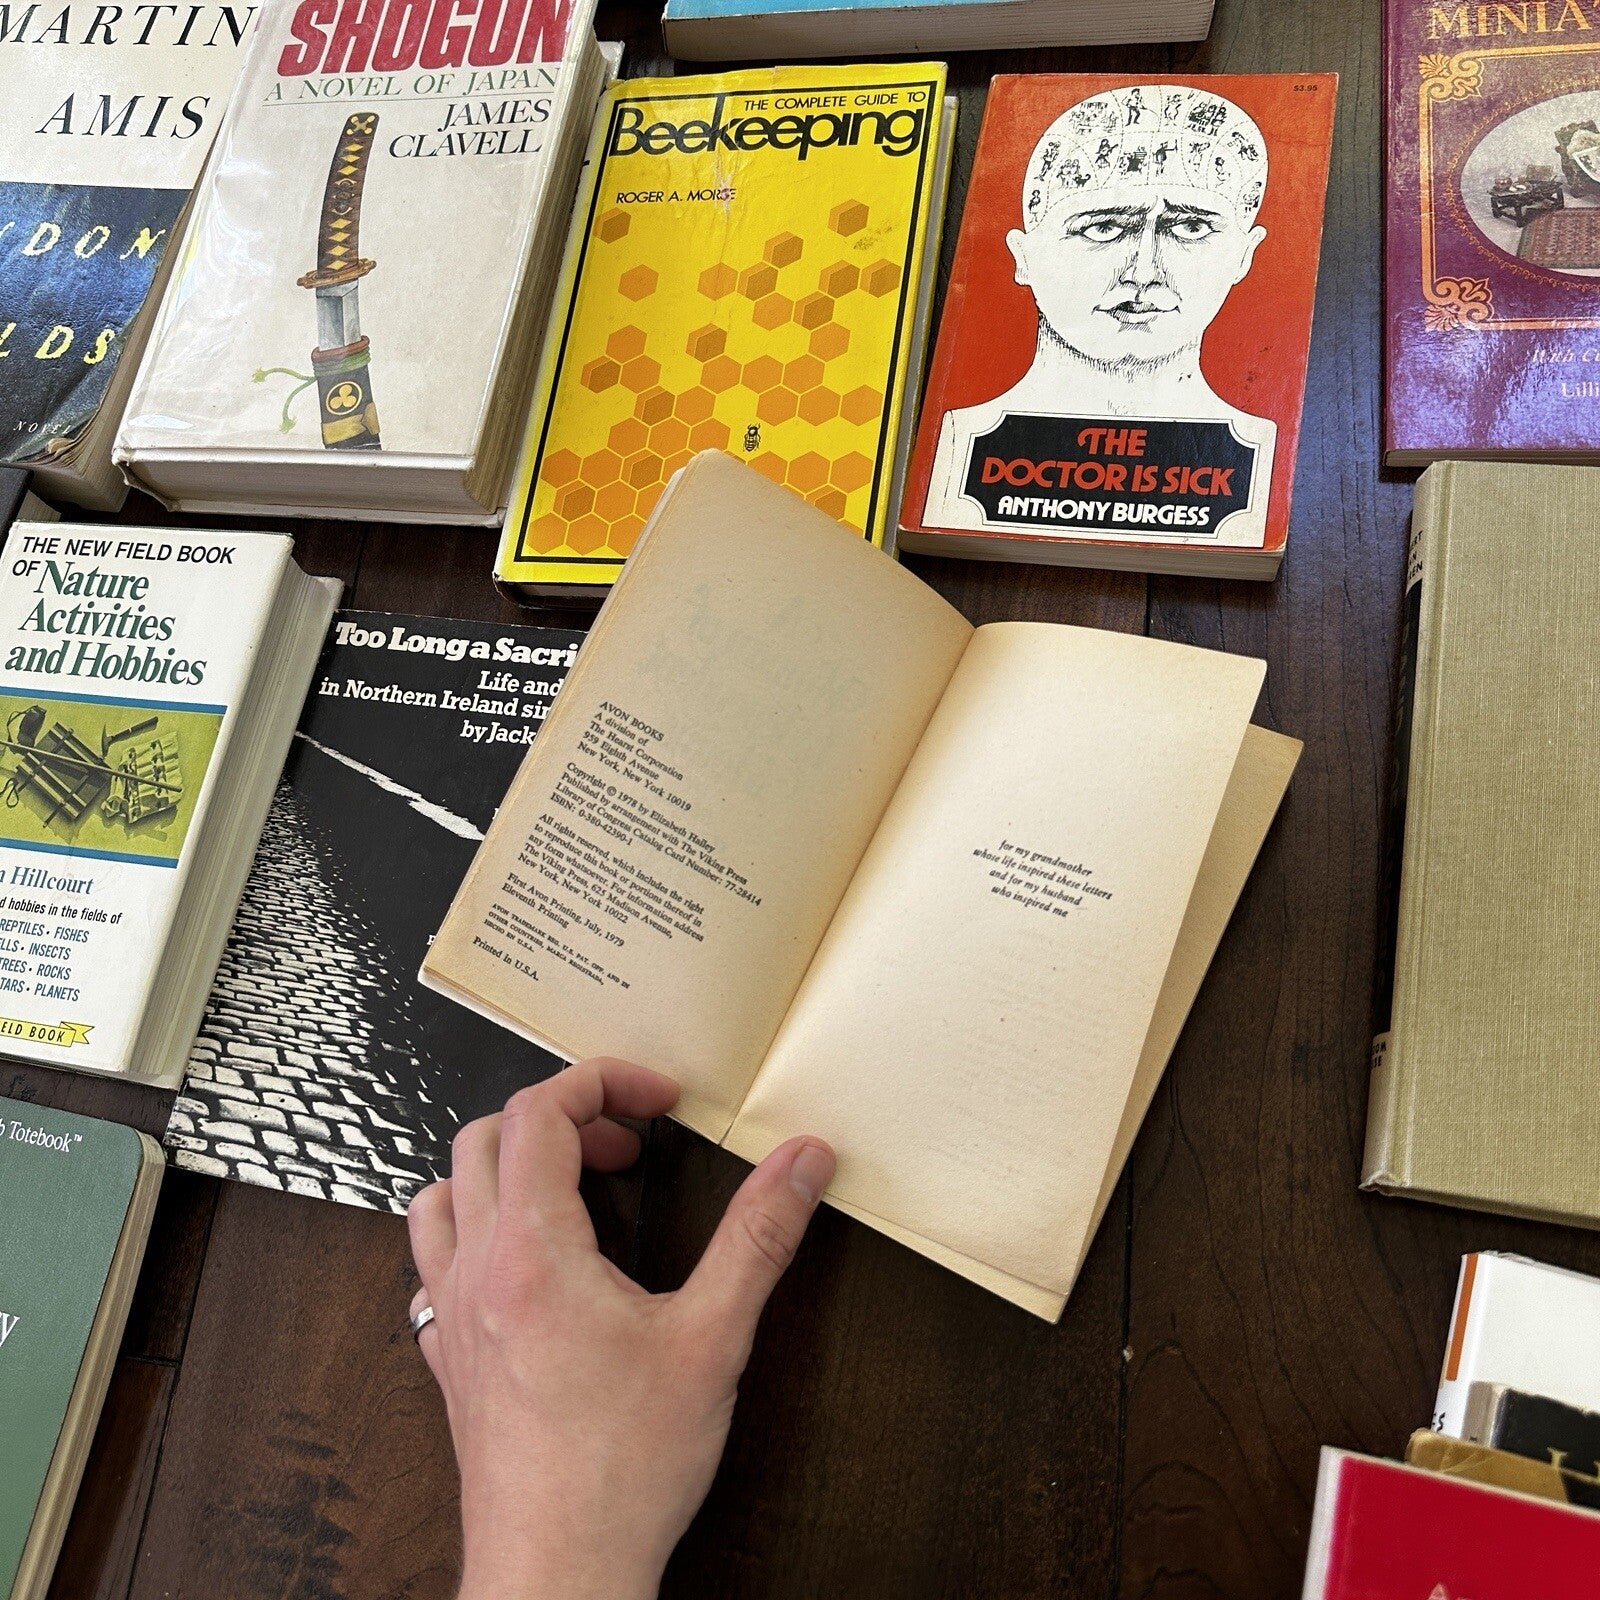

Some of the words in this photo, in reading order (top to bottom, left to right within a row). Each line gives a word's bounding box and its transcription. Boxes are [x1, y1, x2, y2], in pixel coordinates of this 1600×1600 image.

[0, 4, 258, 47] MARTIN
[277, 0, 572, 76] SHOGUN
[1427, 0, 1600, 40] MINIA
[265, 82, 282, 101] A
[298, 77, 403, 99] NOVEL
[413, 73, 455, 95] OF
[463, 68, 561, 96] JAPAN
[745, 100, 768, 111] THE
[775, 96, 847, 109] COMPLETE
[855, 93, 898, 105] GUIDE
[907, 91, 927, 103] TO
[1293, 84, 1319, 92] $3.95
[35, 92, 210, 139] AMIS
[438, 99, 552, 132] JAMES
[608, 93, 924, 161] Beekeeping
[389, 129, 545, 158] CLAVELL
[616, 191, 664, 204] ROGER
[668, 190, 683, 202] A.
[1077, 427, 1147, 456] THE
[981, 456, 1128, 492] DOCTOR
[1131, 465, 1158, 493] IS
[1161, 466, 1236, 496] SICK
[997, 495, 1112, 522] ANTHONY
[1112, 503, 1210, 526] BURGESS
[23, 536, 61, 554] THE
[68, 539, 113, 557] NEW
[115, 541, 172, 561] FIELD
[176, 545, 236, 565] BOOK
[12, 560, 41, 577] OF
[33, 560, 149, 600] Nature
[18, 598, 176, 641] Activities
[336, 622, 387, 648] Too
[388, 627, 471, 661] Long
[469, 643, 491, 659] a
[5, 640, 69, 674] and
[67, 641, 207, 686] Hobbies
[477, 670, 520, 693] Life
[319, 677, 340, 696] in
[343, 679, 437, 708] Northern
[439, 690, 518, 717] Ireland
[459, 720, 488, 743] by
[486, 722, 537, 745] Jack
[600, 701, 630, 722] AVON
[631, 717, 665, 742] BOOKS
[605, 718, 636, 740] division
[583, 731, 599, 744] 959
[600, 741, 627, 762] Eighth
[628, 759, 659, 780] Avenue
[590, 720, 605, 735] The
[607, 731, 634, 752] Hearst
[636, 748, 683, 781] Corporation
[577, 741, 597, 757] New
[599, 752, 620, 773] York,
[622, 767, 642, 783] New
[644, 779, 665, 797] York
[666, 793, 692, 811] 10019
[550, 792, 576, 812] ISBN:
[578, 809, 633, 846] 0-380-42390-1
[567, 762, 606, 790] Copyright
[617, 791, 638, 808] 1978
[638, 803, 649, 815] by
[650, 810, 687, 837] Elizabeth
[688, 832, 715, 853] Hailey
[555, 782, 586, 805] Library
[585, 801, 599, 812] of
[597, 807, 631, 832] Congress
[633, 828, 664, 852] Catalog
[664, 847, 686, 863] Card
[686, 858, 723, 884] Number:
[725, 880, 762, 906] 77-28414
[561, 772, 600, 799] Published
[600, 794, 611, 806] by
[611, 804, 661, 835] arrangement
[662, 832, 679, 846] with
[681, 841, 696, 856] The
[700, 851, 725, 873] Viking
[725, 867, 748, 885] Press
[539, 813, 554, 825] All
[553, 822, 576, 839] rights
[576, 836, 610, 861] reserved,
[613, 857, 635, 875] which
[636, 869, 669, 894] includes
[669, 890, 683, 902] the
[683, 899, 704, 915] right
[544, 830, 582, 856] reproduce
[583, 853, 598, 866] this
[599, 861, 619, 878] book
[629, 882, 662, 904] portions
[663, 901, 694, 921] thereof
[972, 849, 1001, 862] whose
[1001, 855, 1017, 868] life
[1017, 864, 1057, 881] inspired
[1056, 875, 1081, 889] these
[1082, 882, 1113, 900] letters
[998, 839, 1014, 851] for
[1015, 847, 1030, 859] my
[1030, 852, 1093, 876] grandmother
[10, 866, 94, 895] Hillcourt
[517, 852, 537, 868] New
[539, 864, 559, 885] York,
[561, 878, 581, 894] New
[583, 890, 602, 909] York
[604, 905, 628, 924] 10022
[524, 842, 540, 857] The
[542, 852, 567, 874] Viking
[567, 869, 588, 888] Press,
[591, 884, 607, 896] 625
[606, 893, 640, 918] Madison
[640, 915, 673, 939] Avenue,
[528, 834, 544, 847] any
[544, 842, 564, 859] form
[566, 856, 608, 886] whatsoever.
[610, 882, 626, 895] For
[627, 891, 673, 924] information
[673, 921, 704, 942] address
[988, 869, 1010, 881] and
[1007, 874, 1023, 885] for
[1024, 882, 1040, 893] my
[1041, 885, 1083, 906] husband
[8, 897, 46, 914] hobbies
[48, 903, 58, 916] in
[61, 905, 78, 919] the
[80, 907, 107, 923] fields
[110, 912, 123, 924] of
[501, 882, 536, 908] Eleventh
[537, 903, 569, 929] Printing
[507, 872, 527, 889] First
[527, 885, 549, 903] Avon
[549, 898, 582, 924] Printing,
[584, 918, 602, 937] July,
[604, 931, 625, 947] 1979
[991, 886, 1012, 898] who
[1013, 893, 1053, 912] inspired
[1052, 907, 1068, 918] me
[0, 918, 45, 937] REPTILES
[54, 926, 90, 943] FISHES
[28, 942, 71, 960] INSECTS
[473, 936, 503, 958] Printed
[514, 959, 539, 981] U.S.A.
[36, 963, 72, 980] ROCKS
[34, 983, 80, 1001] PLANETS
[29, 1026, 66, 1042] BOOK
